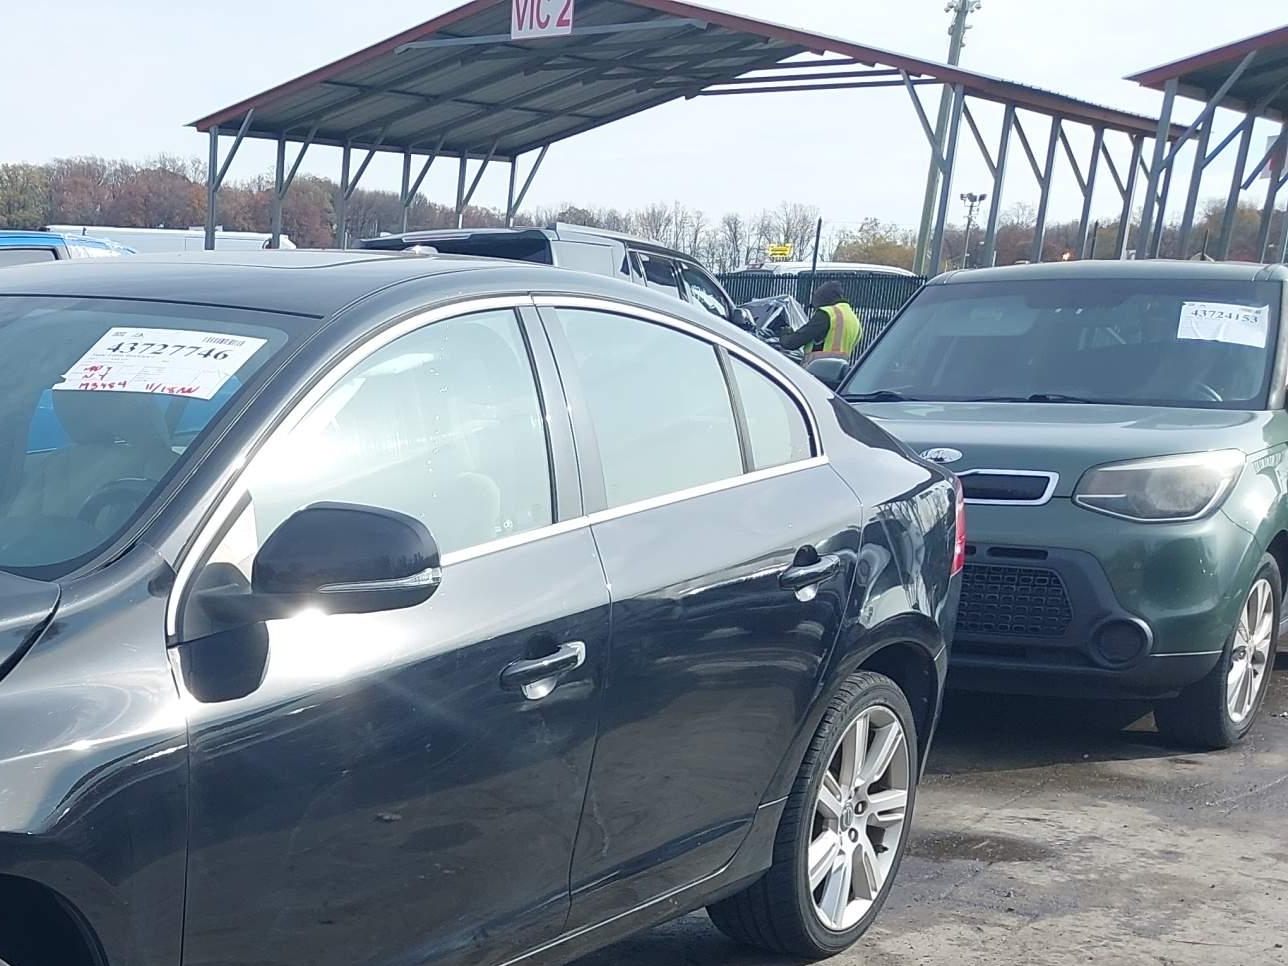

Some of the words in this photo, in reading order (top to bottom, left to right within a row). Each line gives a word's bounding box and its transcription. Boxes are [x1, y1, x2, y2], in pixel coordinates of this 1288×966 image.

[514, 0, 551, 31] VIC
[556, 0, 572, 28] 2
[1192, 309, 1258, 323] 43724153
[106, 342, 231, 360] 43727746
